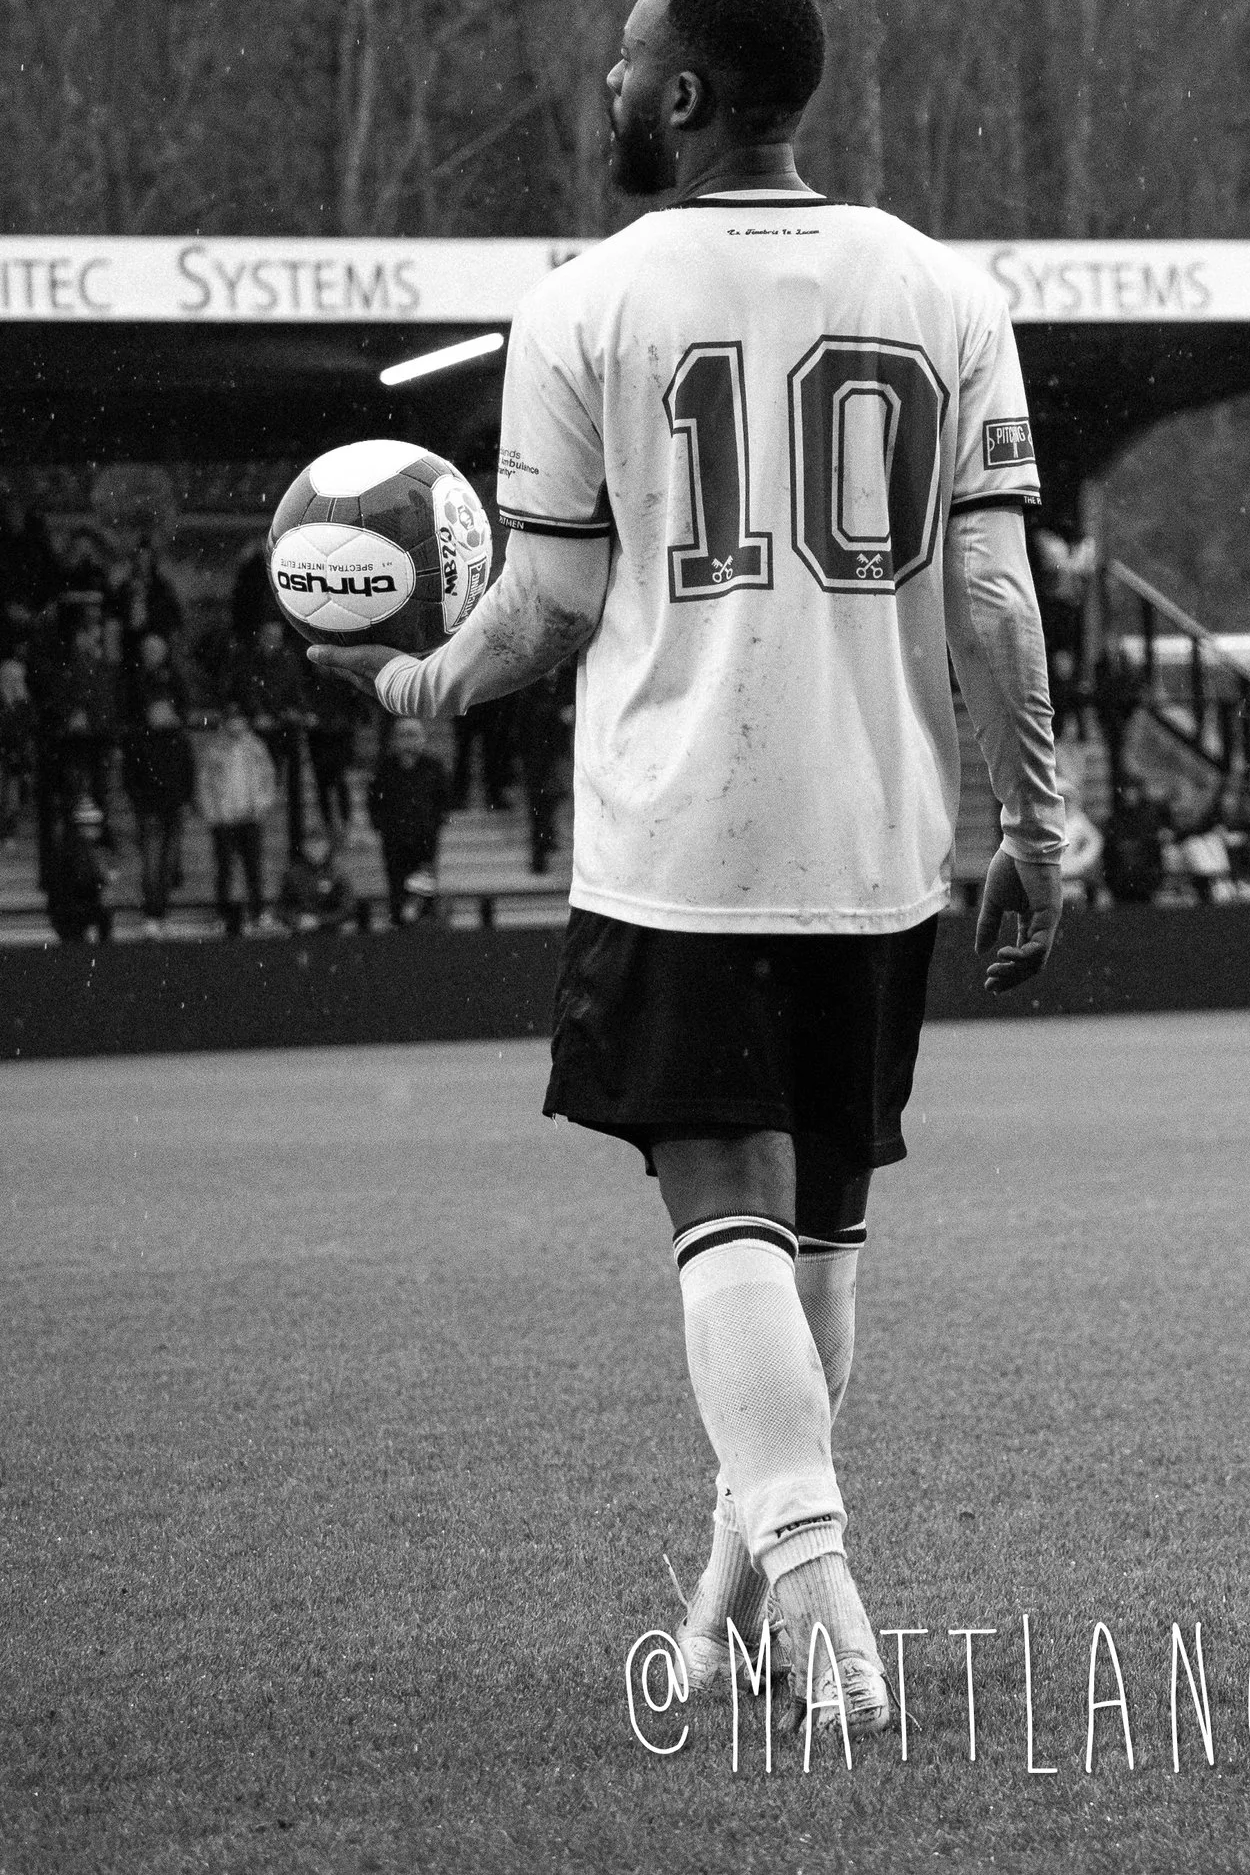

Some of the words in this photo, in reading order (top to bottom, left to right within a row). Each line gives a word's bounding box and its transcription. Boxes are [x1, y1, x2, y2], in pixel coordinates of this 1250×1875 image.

[662, 333, 950, 603] 10
[280, 558, 296, 568] ELITE
[298, 561, 325, 571] INTENT
[328, 563, 374, 572] SPECTRAL
[277, 570, 398, 597] chryso
